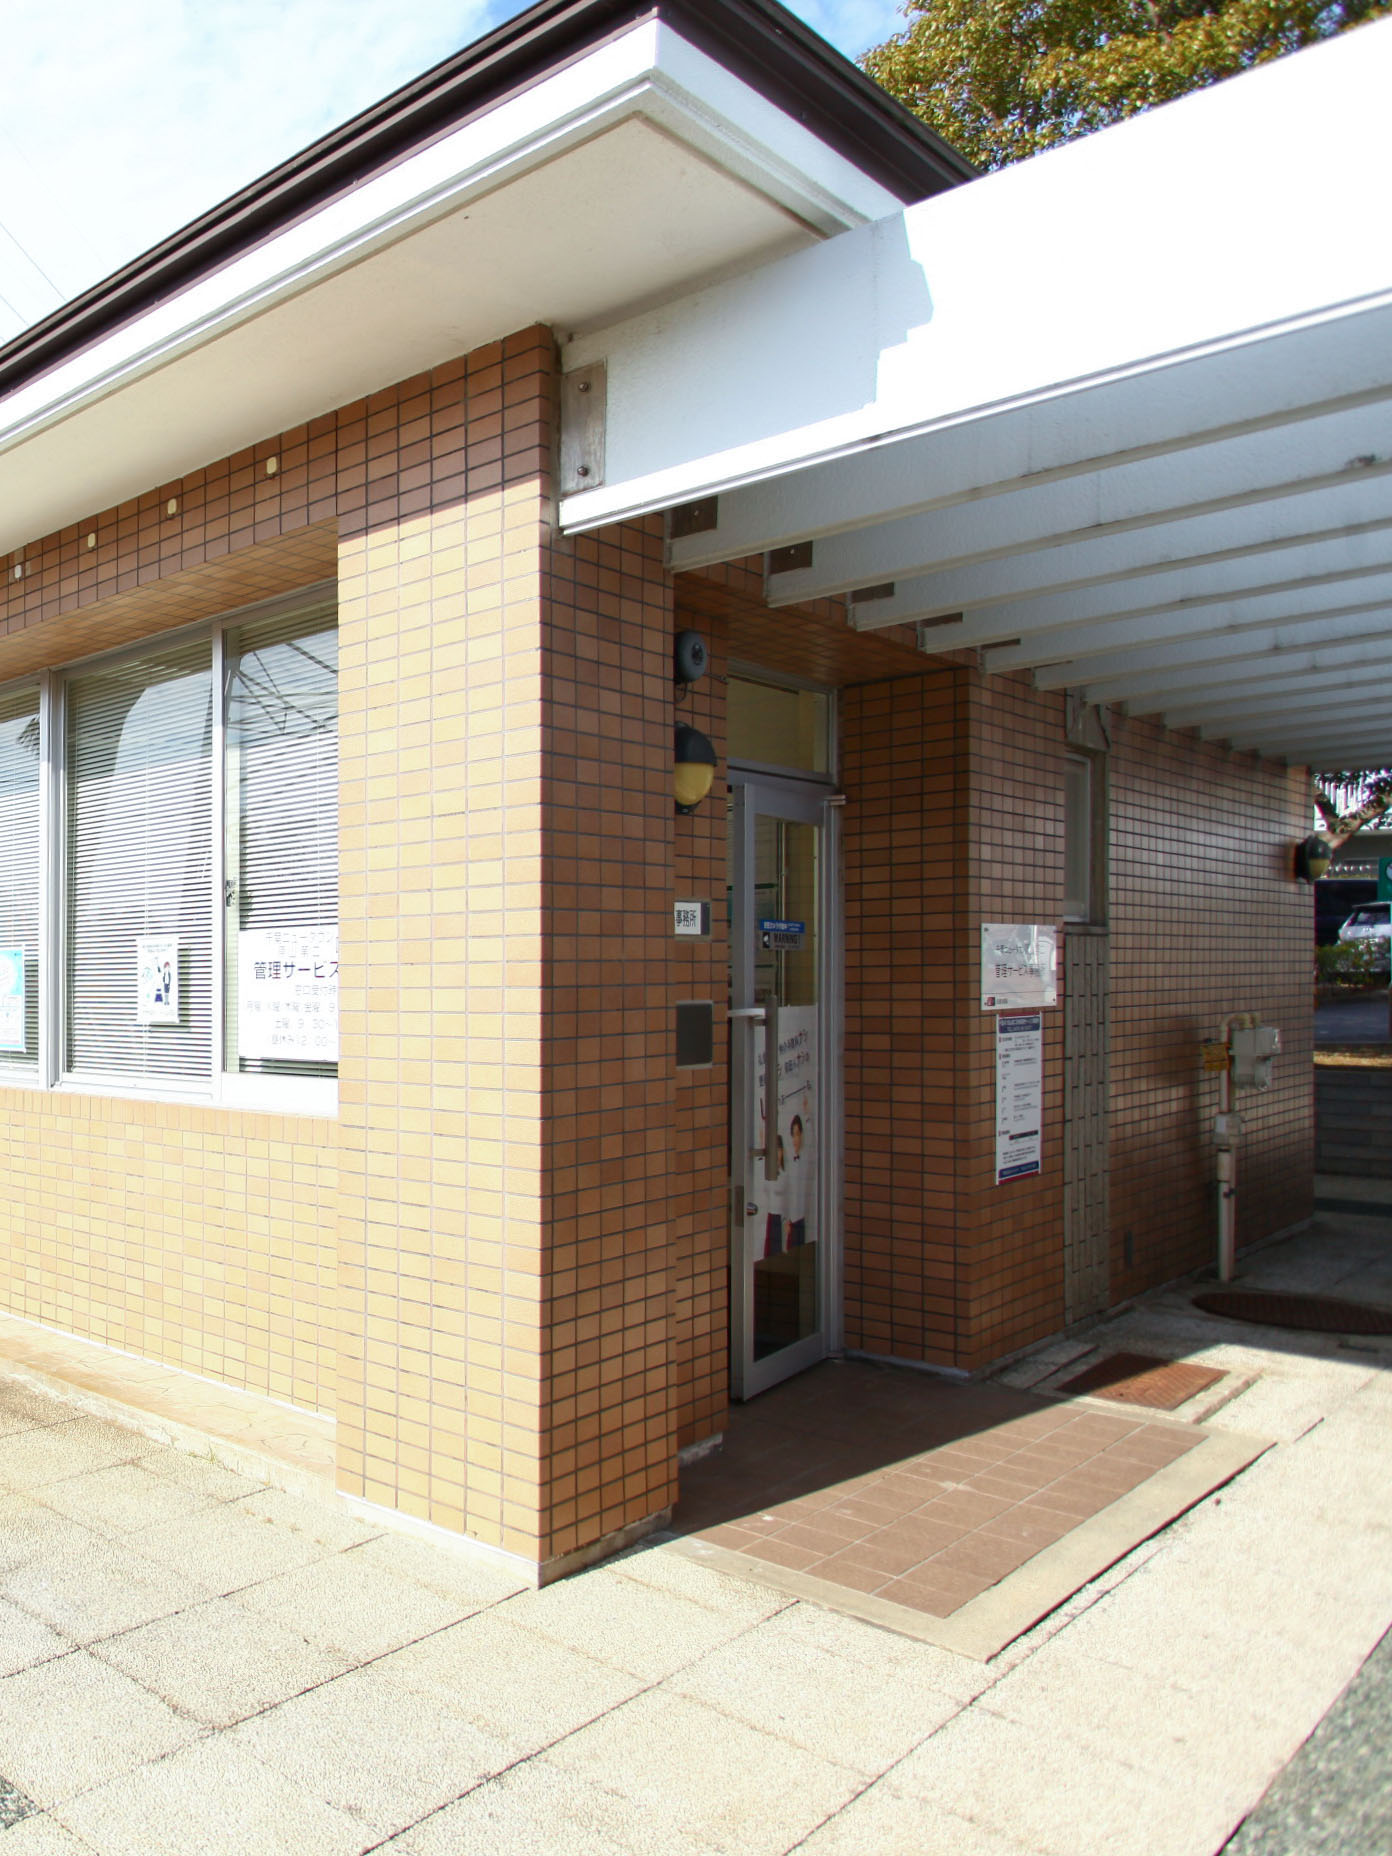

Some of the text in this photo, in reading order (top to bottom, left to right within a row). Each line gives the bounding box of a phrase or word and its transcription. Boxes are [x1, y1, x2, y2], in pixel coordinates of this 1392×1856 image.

[675, 909, 697, 927] 事務所
[254, 960, 339, 980] 管理サービス
